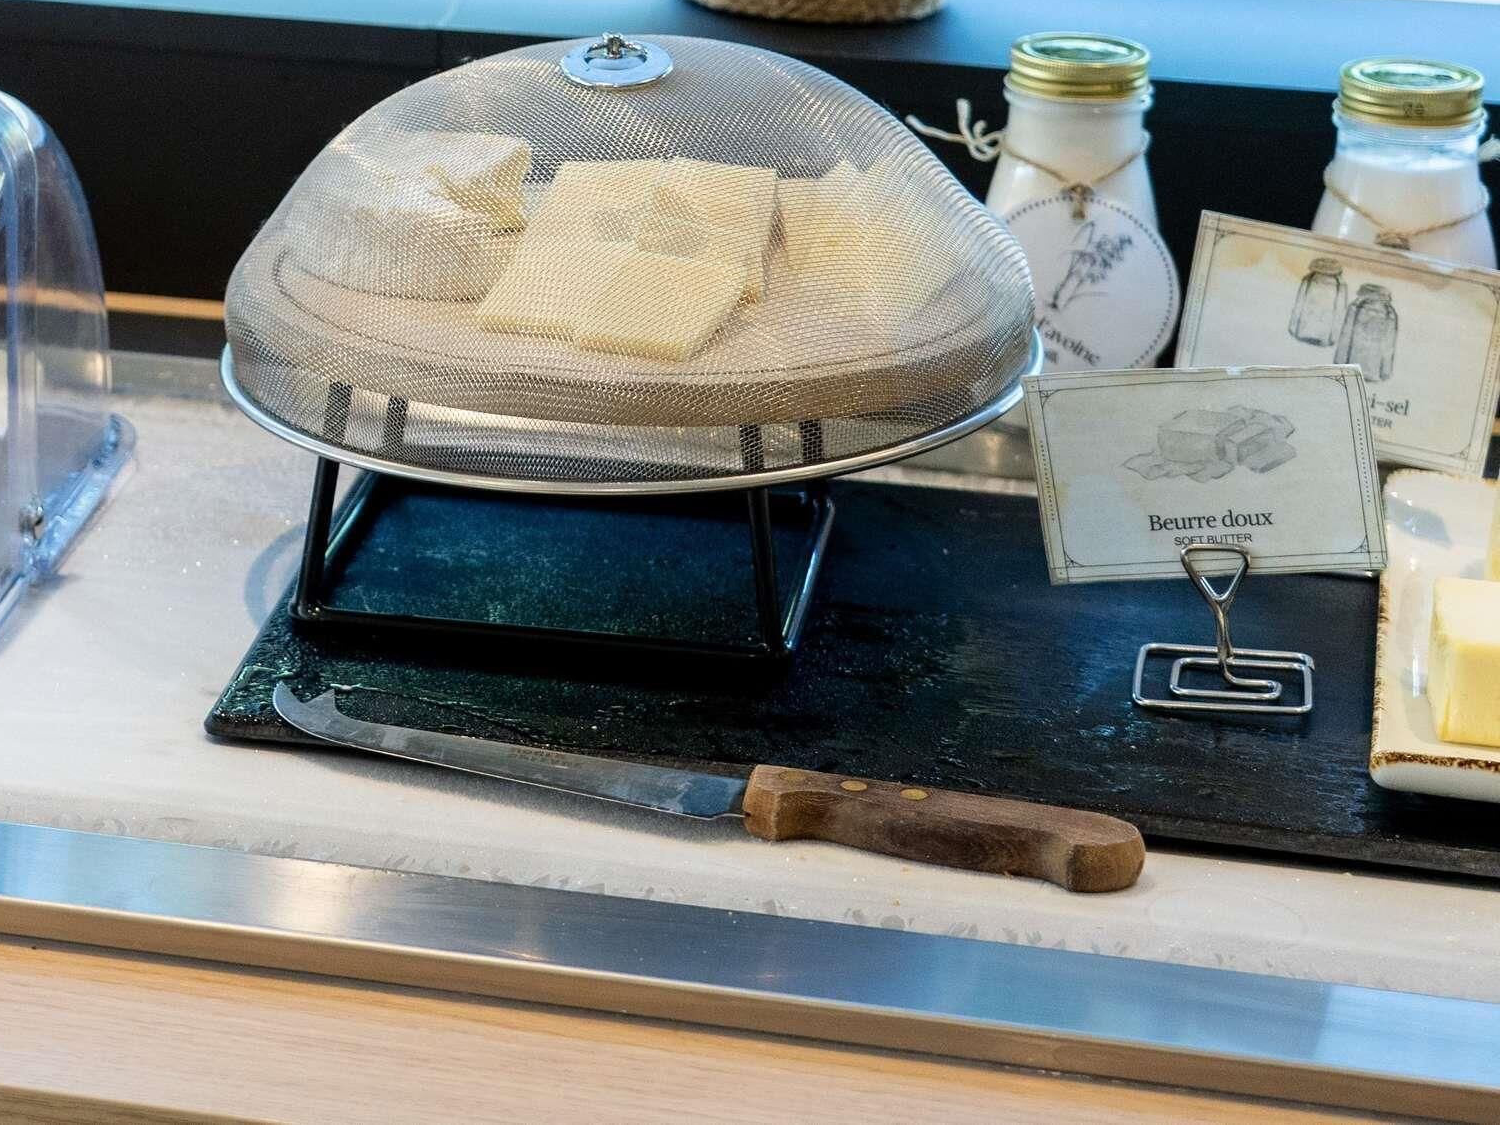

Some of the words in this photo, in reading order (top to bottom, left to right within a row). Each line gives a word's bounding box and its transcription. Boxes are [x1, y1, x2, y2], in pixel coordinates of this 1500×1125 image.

[1369, 392, 1409, 416] i-sel
[1147, 514, 1217, 531] Beurre
[1221, 509, 1274, 528] doux
[1173, 535, 1204, 547] SOFT
[1207, 532, 1253, 545] BUTTER
